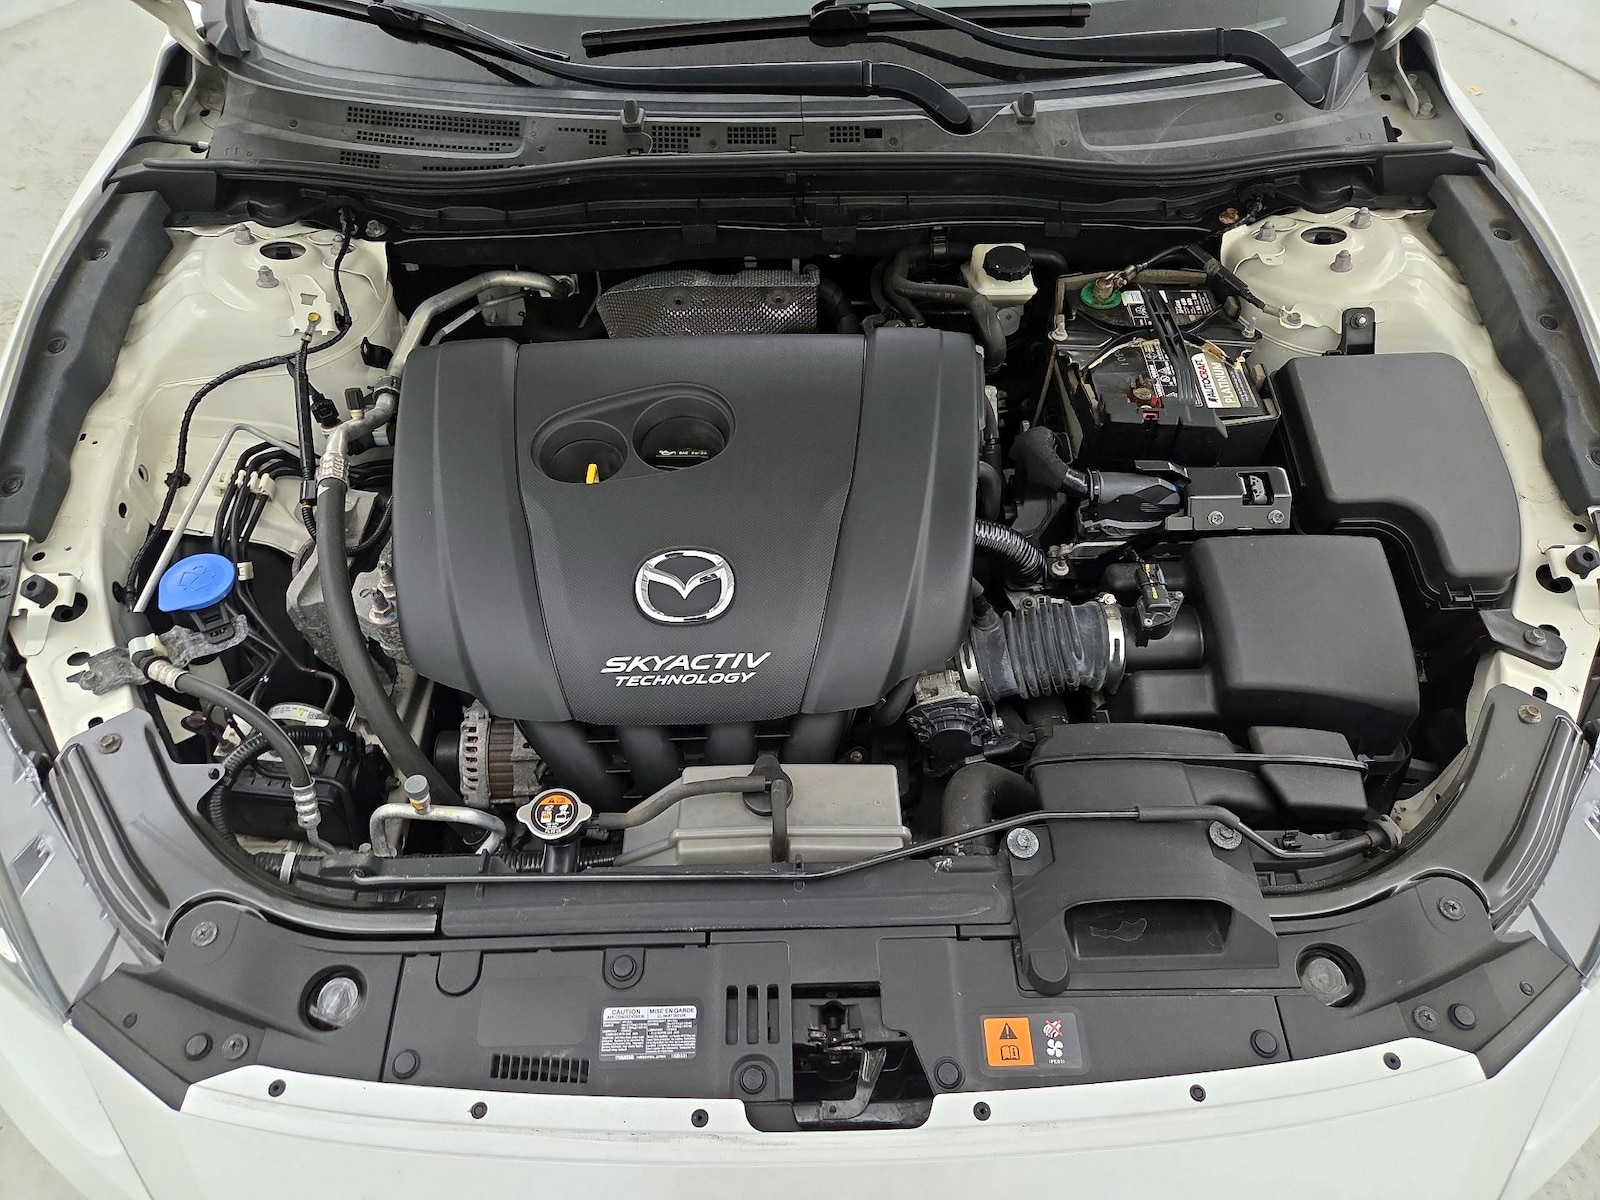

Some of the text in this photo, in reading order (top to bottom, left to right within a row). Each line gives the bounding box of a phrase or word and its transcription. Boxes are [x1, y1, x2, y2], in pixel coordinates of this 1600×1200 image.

[1211, 361, 1236, 403] PLATINUM
[600, 651, 772, 674] SKYACTIV
[615, 671, 757, 687] TECHNOLOGY
